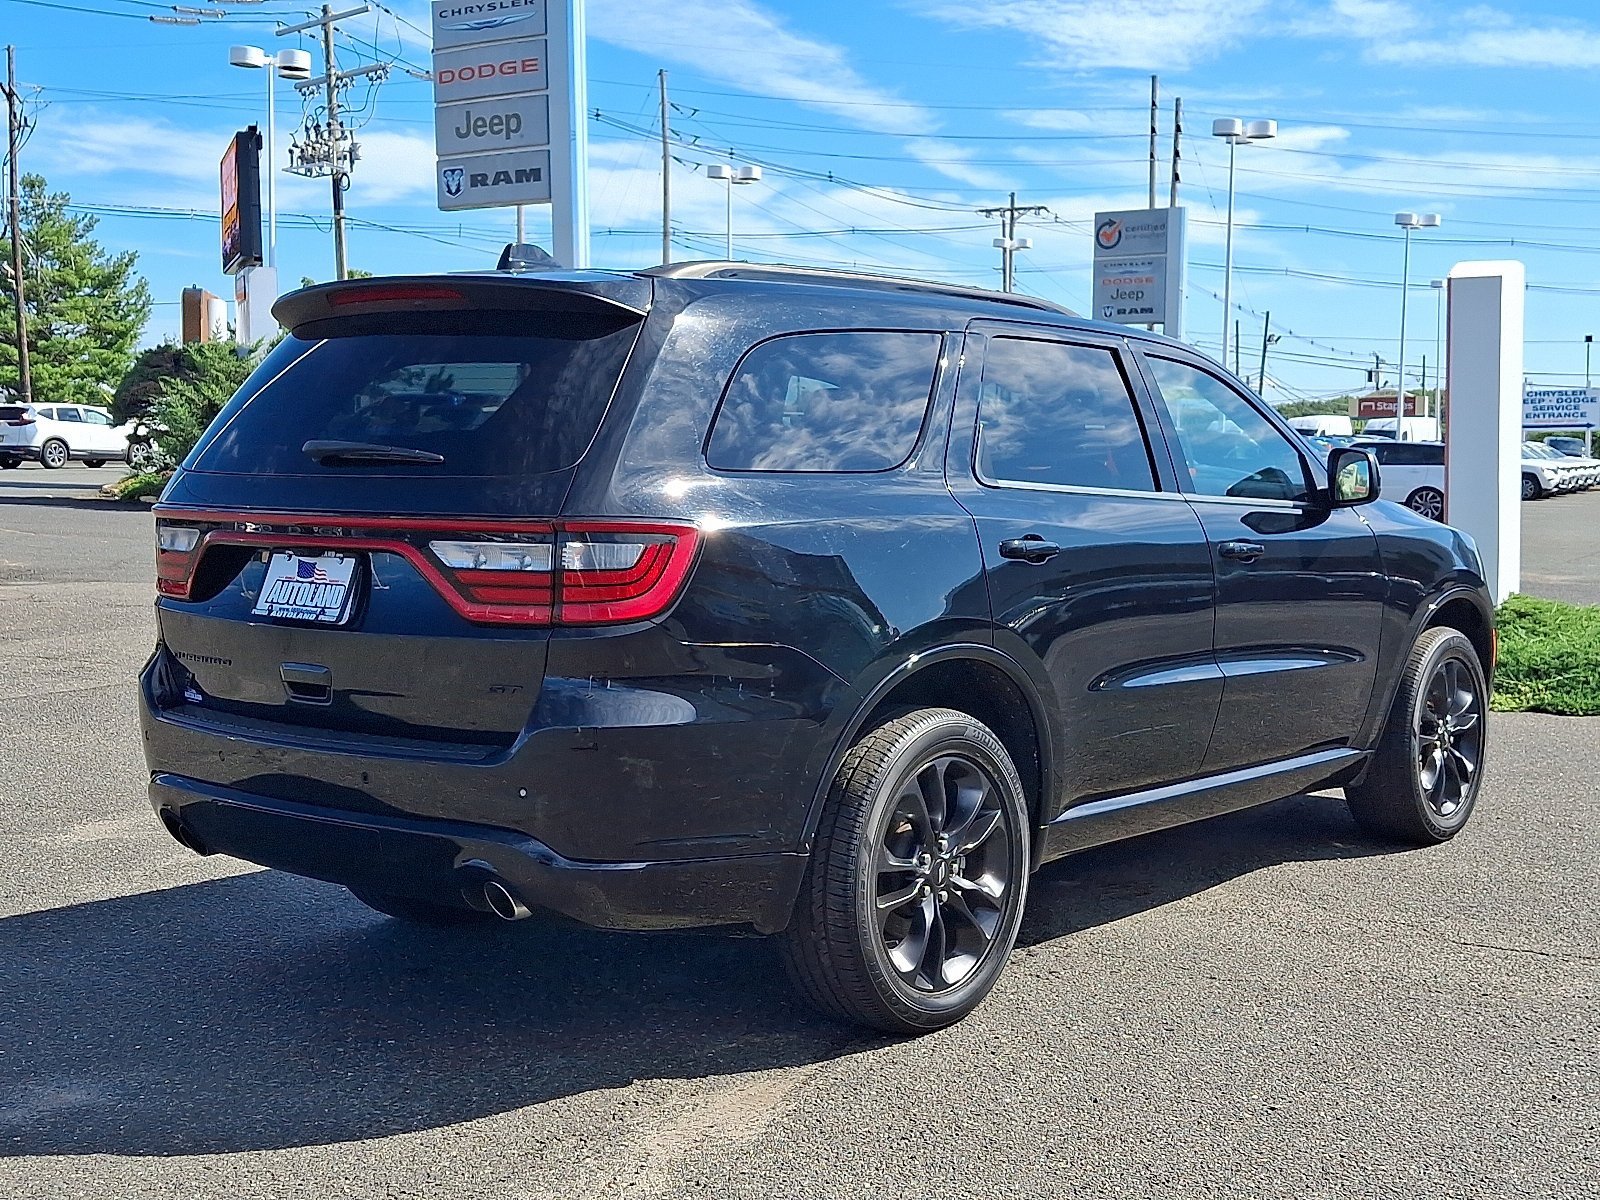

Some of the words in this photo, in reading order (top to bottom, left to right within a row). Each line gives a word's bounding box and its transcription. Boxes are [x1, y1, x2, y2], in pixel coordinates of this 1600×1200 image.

[439, 0, 535, 19] CHRYSLER
[438, 58, 539, 84] DODGE
[455, 110, 522, 140] Jeep
[470, 167, 542, 188] RAM
[1102, 276, 1155, 286] DODGE
[1110, 288, 1145, 301] Jeep
[1117, 307, 1154, 315] RAM
[1526, 390, 1587, 398] CHRYSLER
[1522, 397, 1545, 405] EEP
[1556, 396, 1598, 404] DODGE
[1376, 401, 1414, 413] Stapes
[1532, 404, 1581, 412] SERVICE
[1525, 411, 1588, 419] ENTRANCE
[266, 579, 346, 609] AUTOLAND
[270, 610, 317, 620] AUTOLAND
